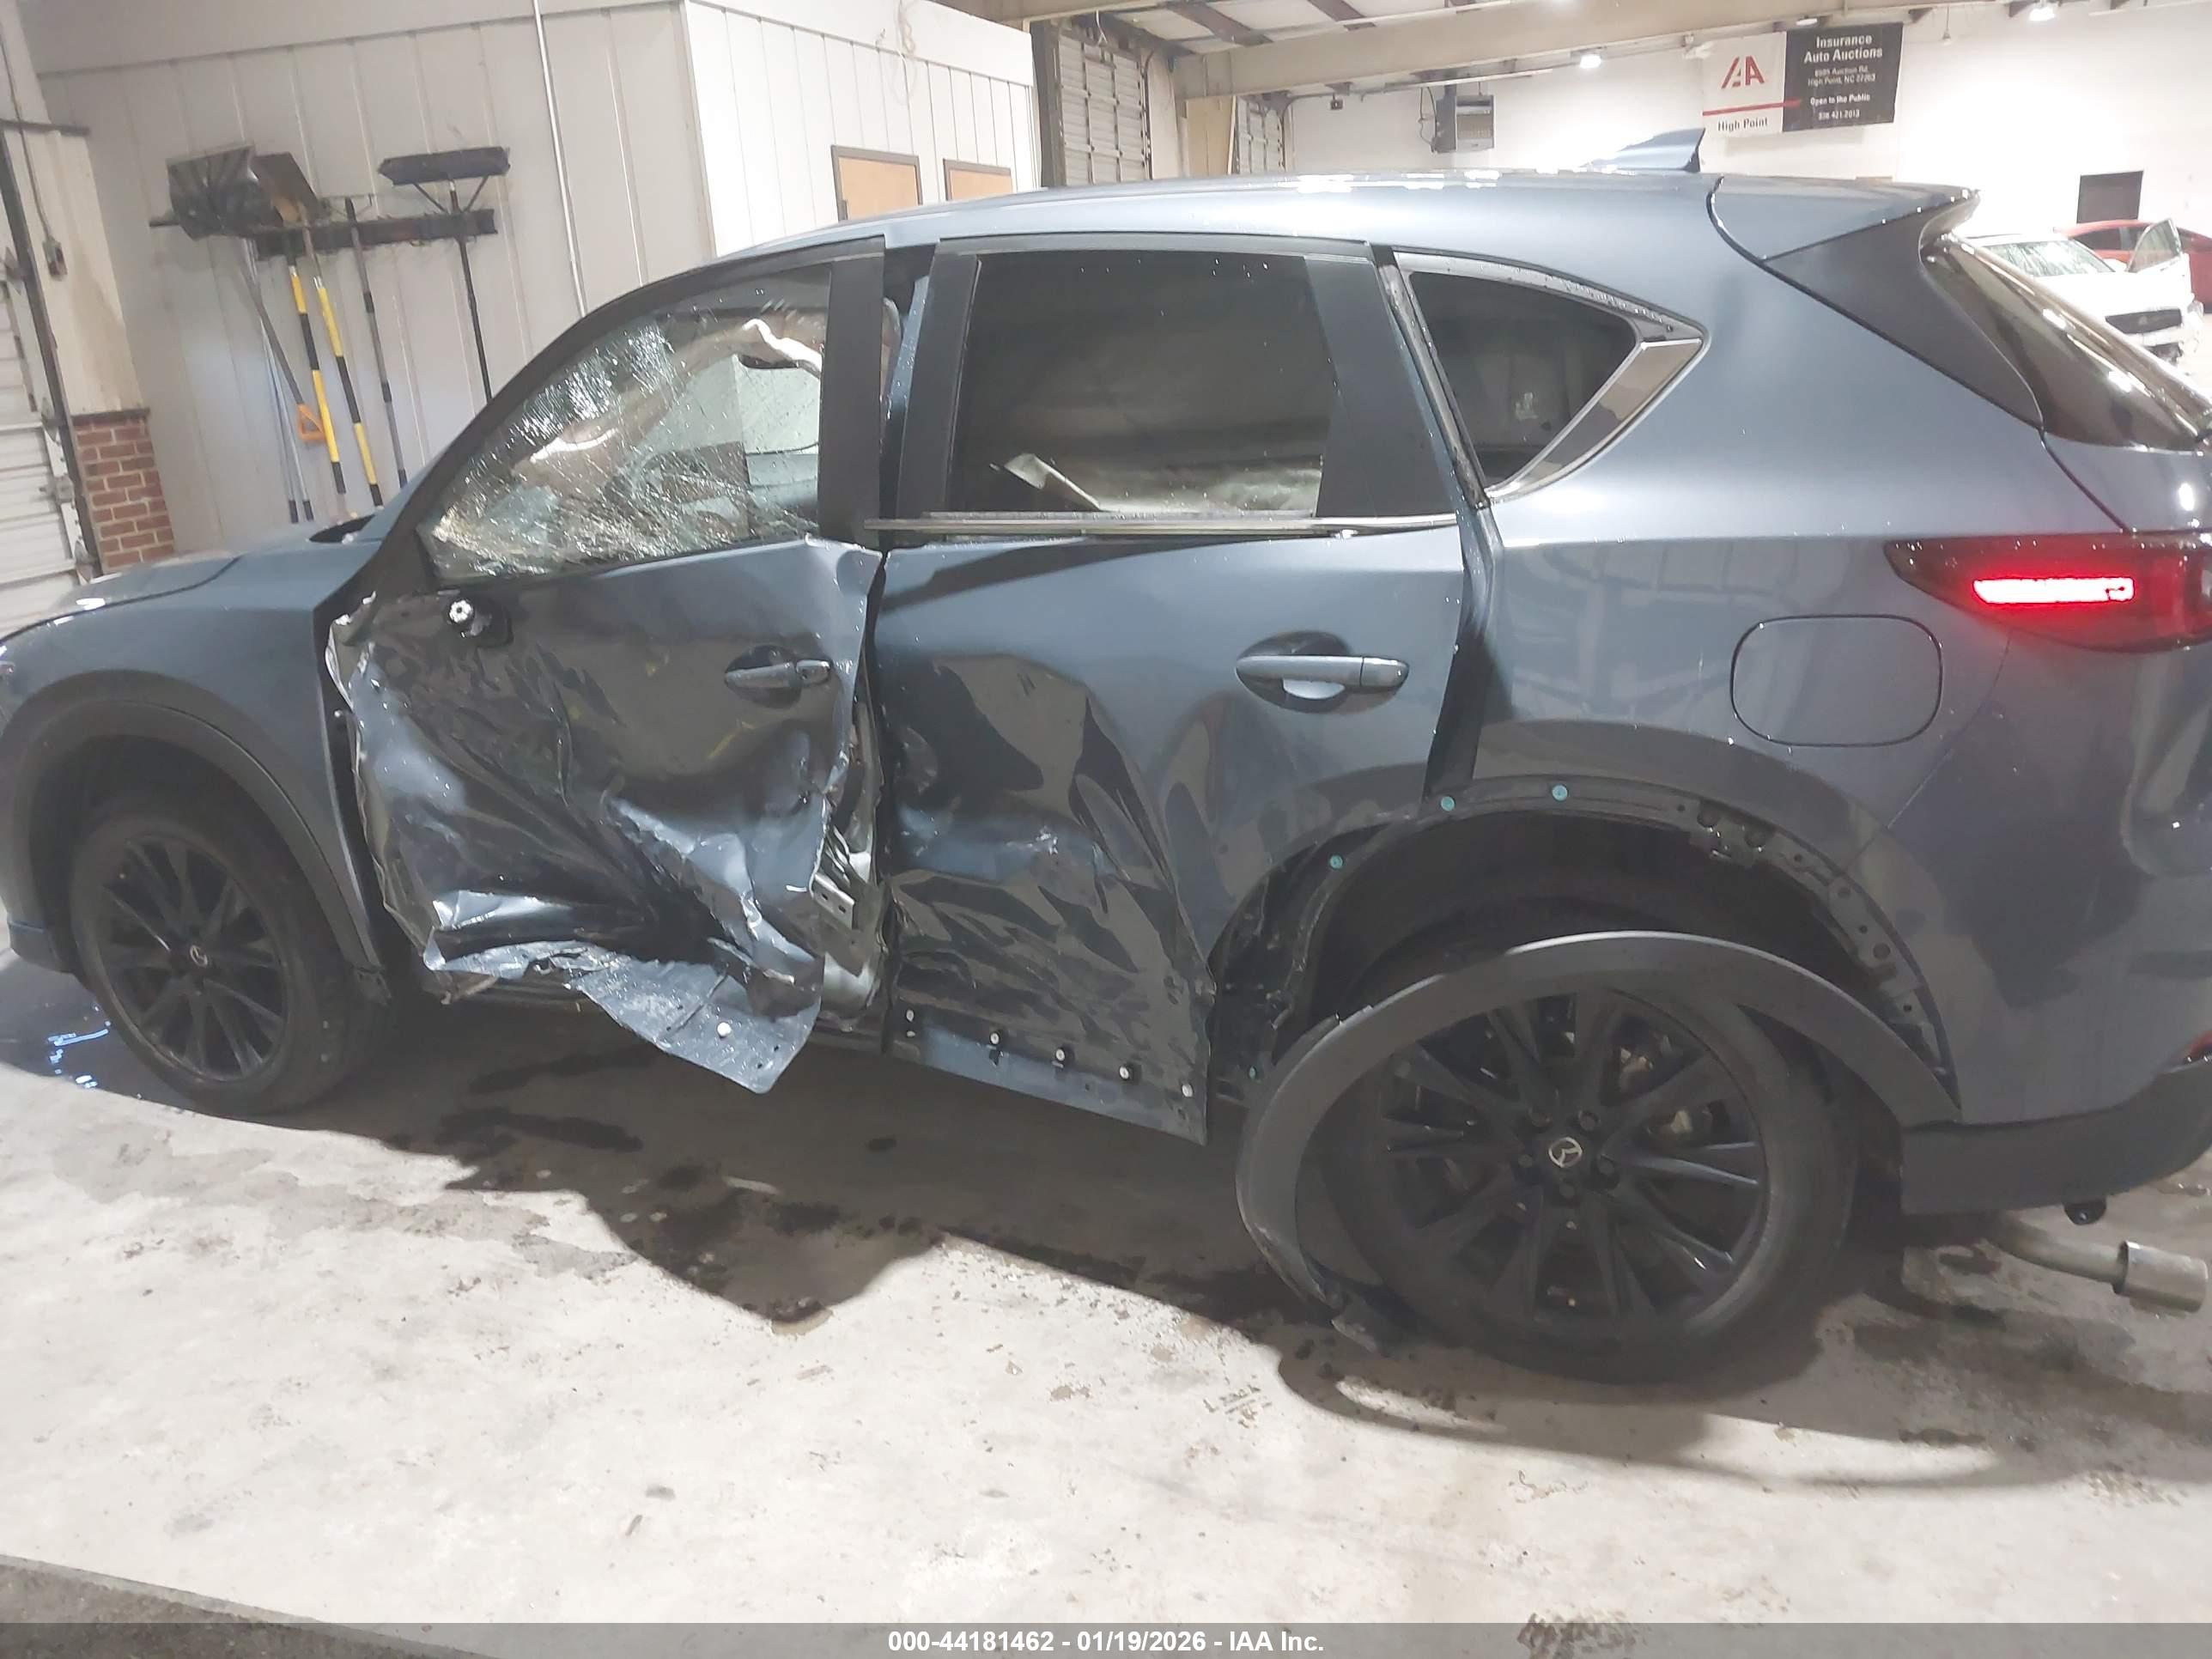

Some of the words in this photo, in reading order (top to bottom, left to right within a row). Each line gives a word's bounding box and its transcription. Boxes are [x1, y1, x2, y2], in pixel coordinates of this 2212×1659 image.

[1816, 35, 1873, 48] Insurance
[1803, 51, 1830, 64] Auto
[1832, 47, 1883, 61] Auctions
[1844, 75, 1855, 83] NC
[1810, 96, 1827, 107] Open
[1828, 95, 1836, 104] to
[1836, 94, 1848, 104] the
[1848, 92, 1870, 103] Public
[1717, 118, 1741, 131] High
[1743, 117, 1768, 129] Point
